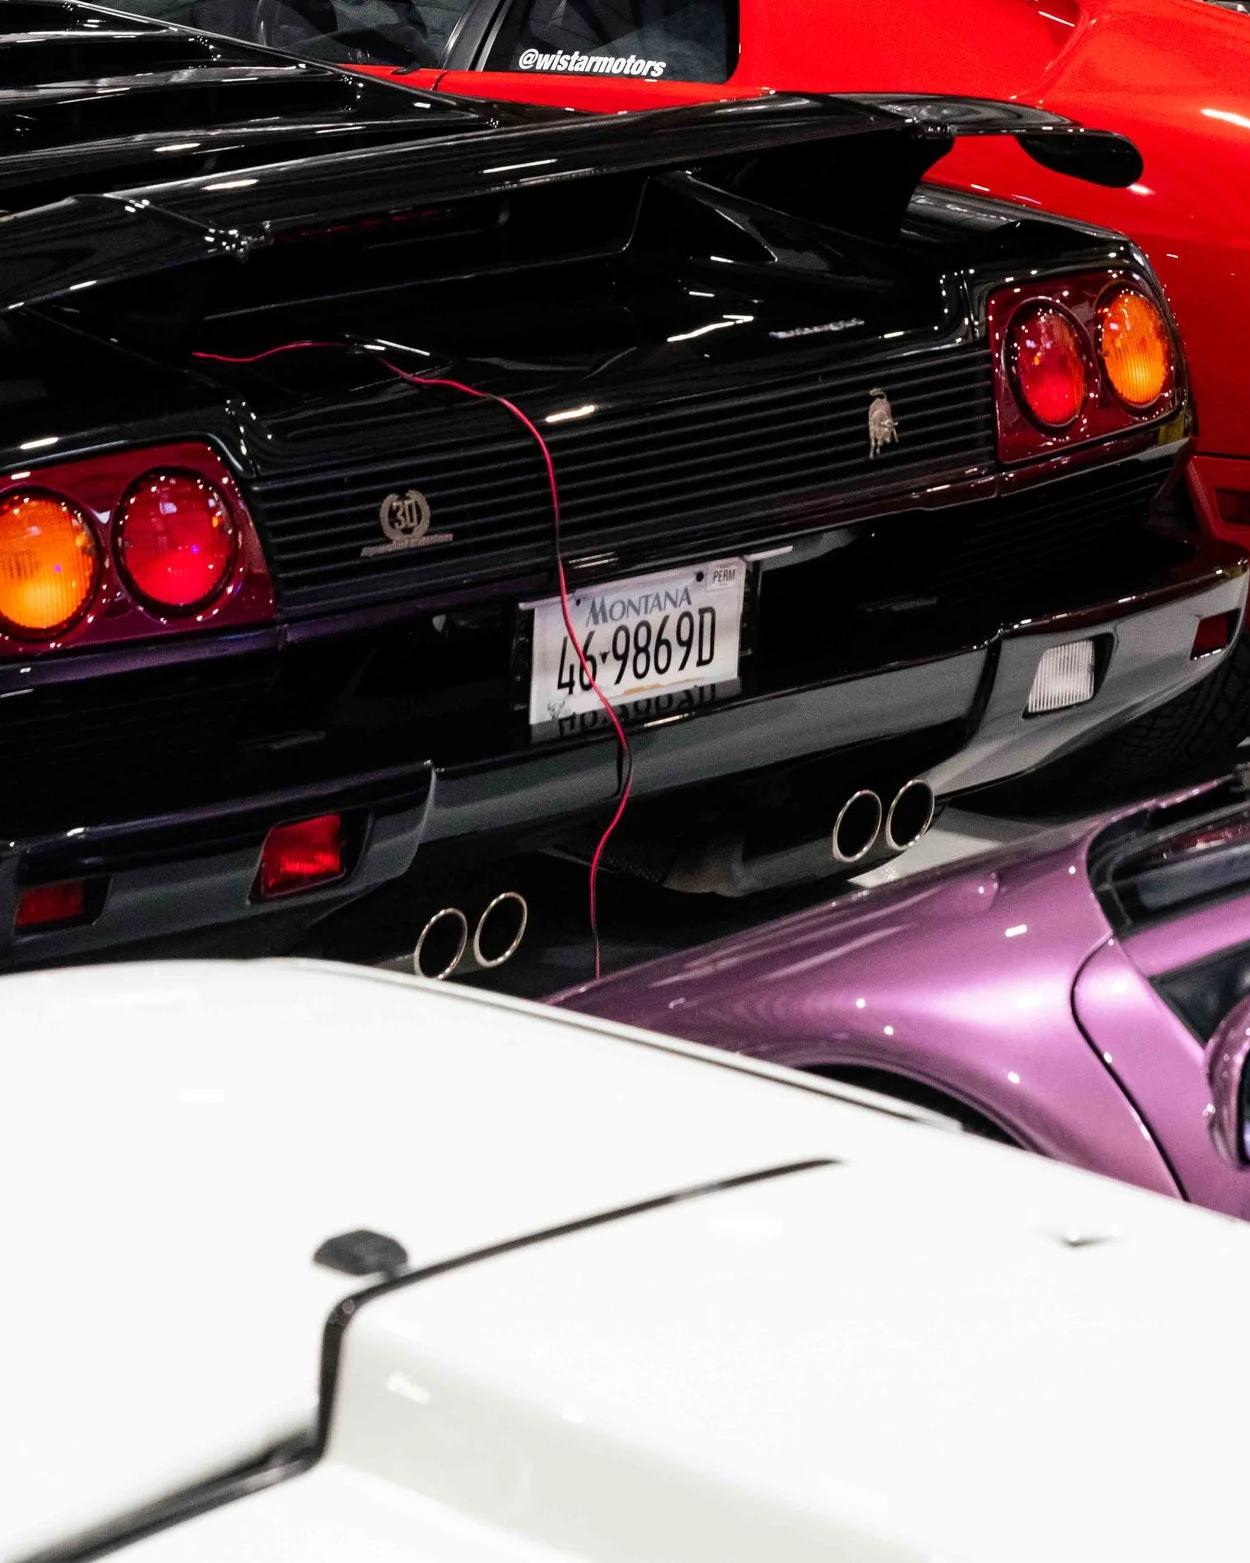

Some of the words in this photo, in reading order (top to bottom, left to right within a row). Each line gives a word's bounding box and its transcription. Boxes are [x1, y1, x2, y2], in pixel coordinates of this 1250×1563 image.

[519, 48, 667, 78] @wistarmotors
[392, 499, 418, 530] 30
[713, 569, 736, 583] PERM
